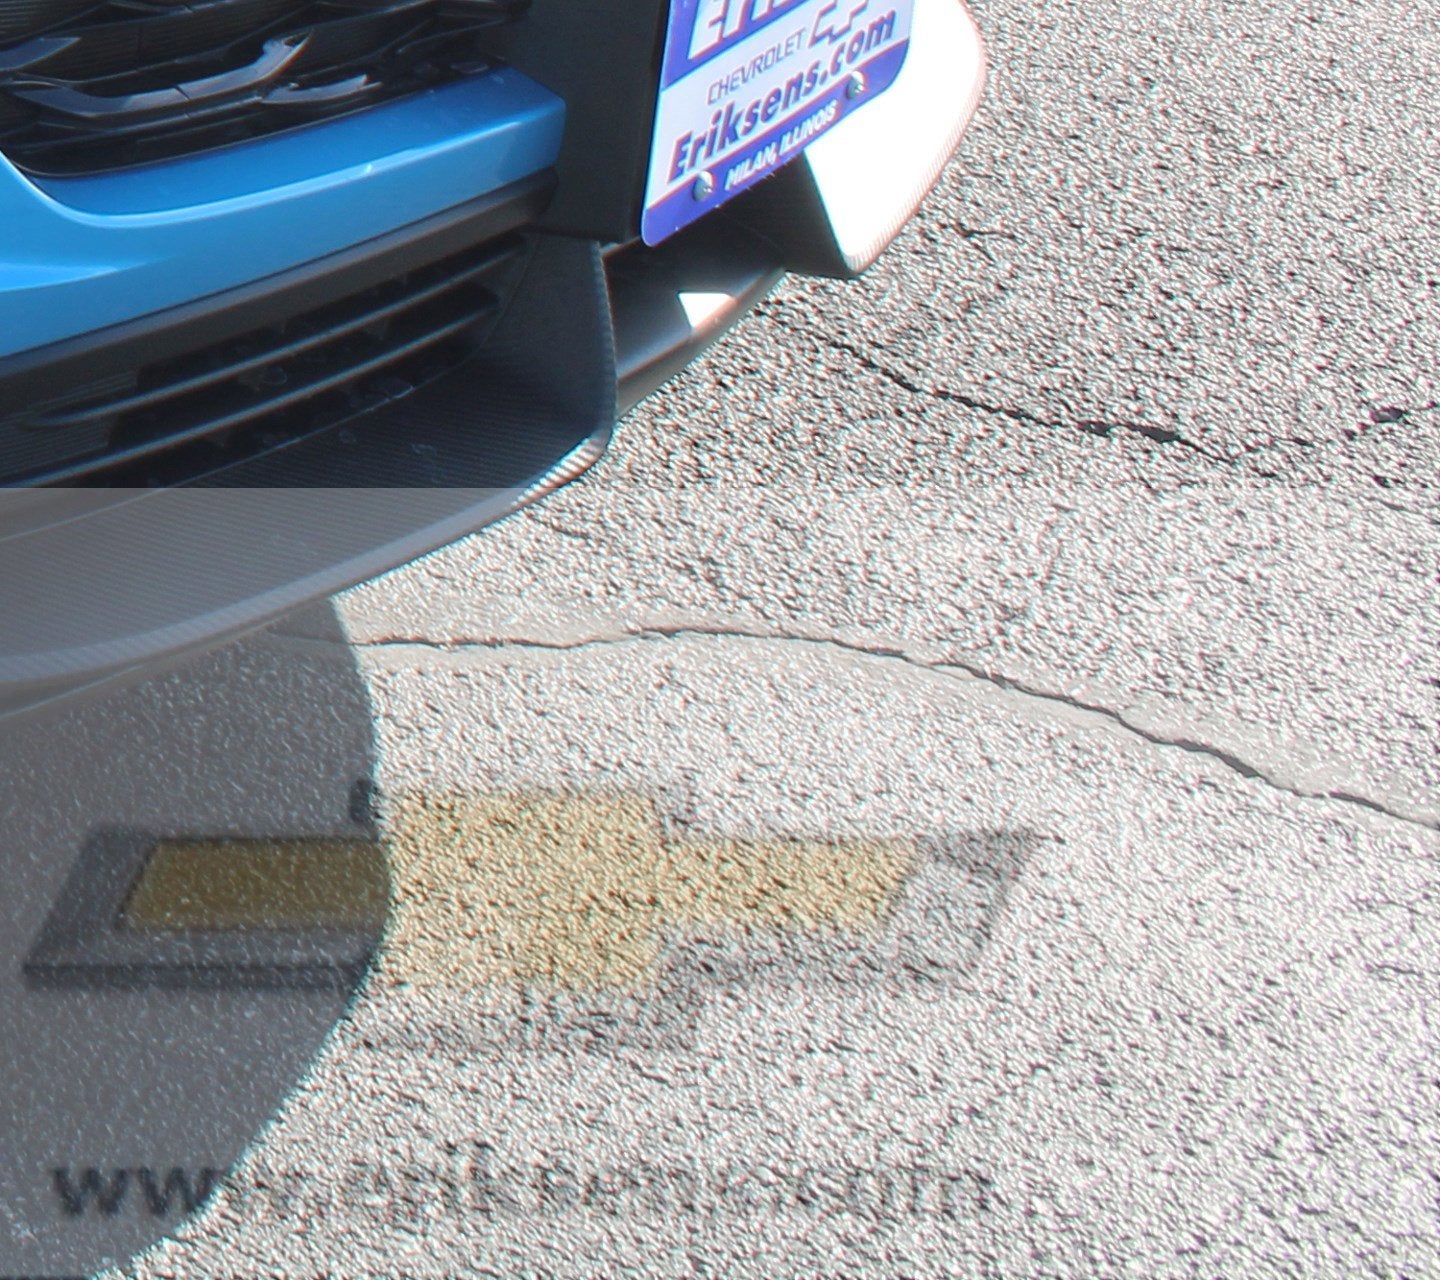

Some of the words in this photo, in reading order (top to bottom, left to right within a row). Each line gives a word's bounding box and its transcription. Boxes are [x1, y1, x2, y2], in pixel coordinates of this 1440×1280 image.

[667, 9, 896, 184] Eriksens.com
[707, 27, 807, 106] CHEVROLET
[780, 99, 839, 156] ILLINOIS
